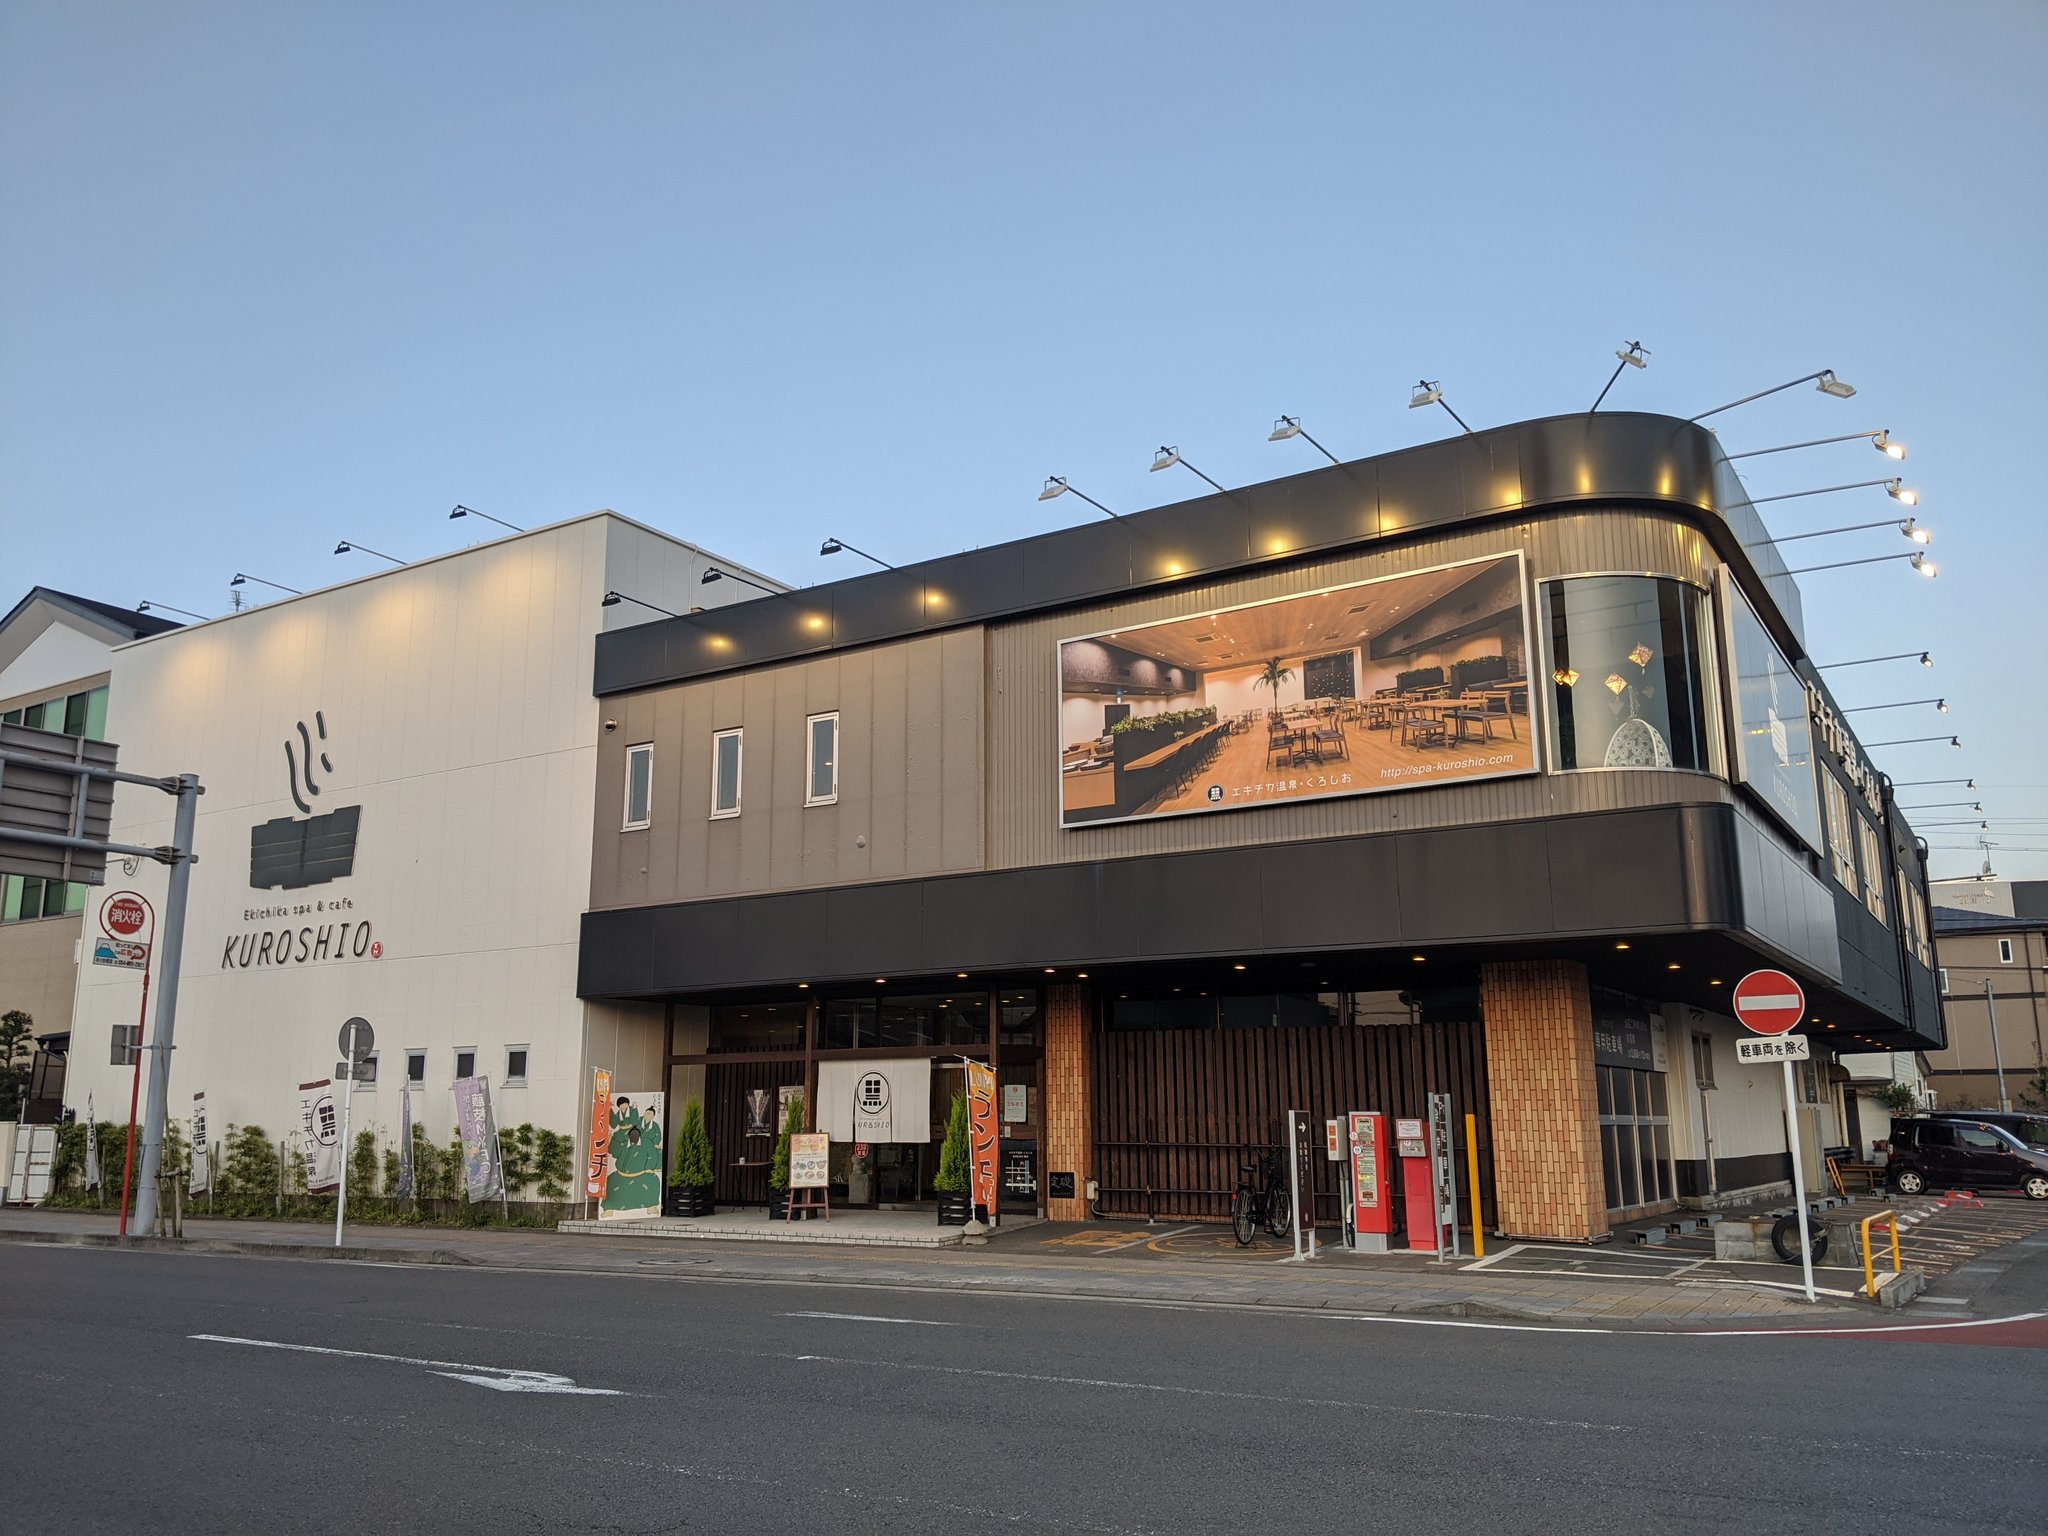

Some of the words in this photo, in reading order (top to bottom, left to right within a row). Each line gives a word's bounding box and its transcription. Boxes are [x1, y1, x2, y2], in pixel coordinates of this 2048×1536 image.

[1380, 753, 1514, 778] http://spa-kuroshio.com
[1231, 773, 1352, 797] エキチカ温泉・くろしお
[111, 908, 143, 925] 消火栓
[244, 905, 289, 921] Ekichika
[293, 903, 312, 916] spa
[317, 900, 325, 912] &
[328, 897, 354, 910] cafe
[221, 919, 373, 970] KUROSHIO
[1740, 1041, 1806, 1058] 軽車両を除く
